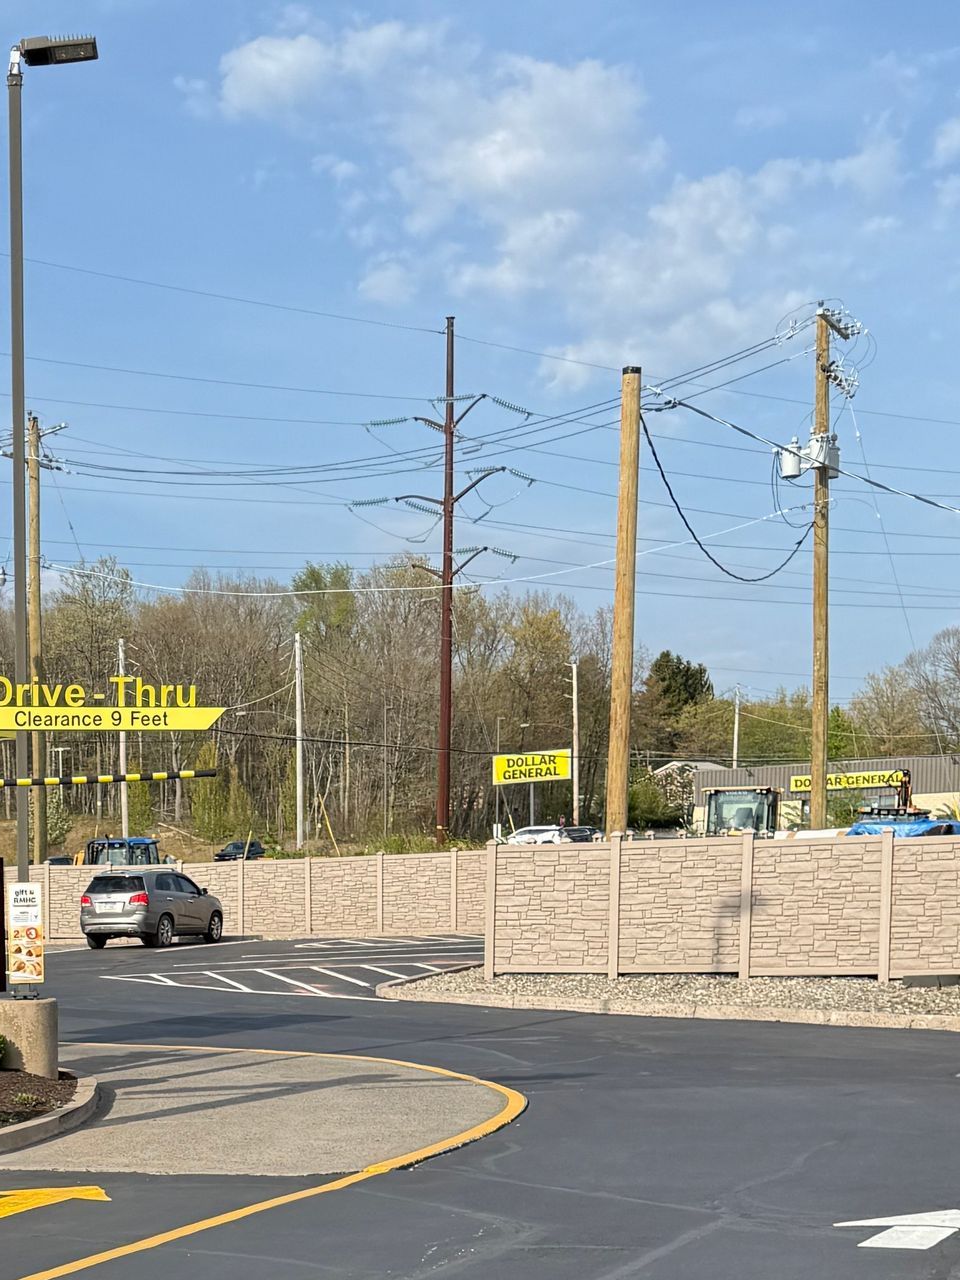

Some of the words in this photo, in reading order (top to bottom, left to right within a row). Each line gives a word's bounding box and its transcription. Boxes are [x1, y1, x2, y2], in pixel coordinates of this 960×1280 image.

[14, 711, 103, 727] Clearance
[111, 711, 122, 727] 9
[130, 711, 169, 727] Feet
[506, 754, 557, 769] DOLLAR
[503, 766, 561, 780] GENERAL
[794, 777, 842, 788] DOAR
[846, 774, 901, 785] GENERAL
